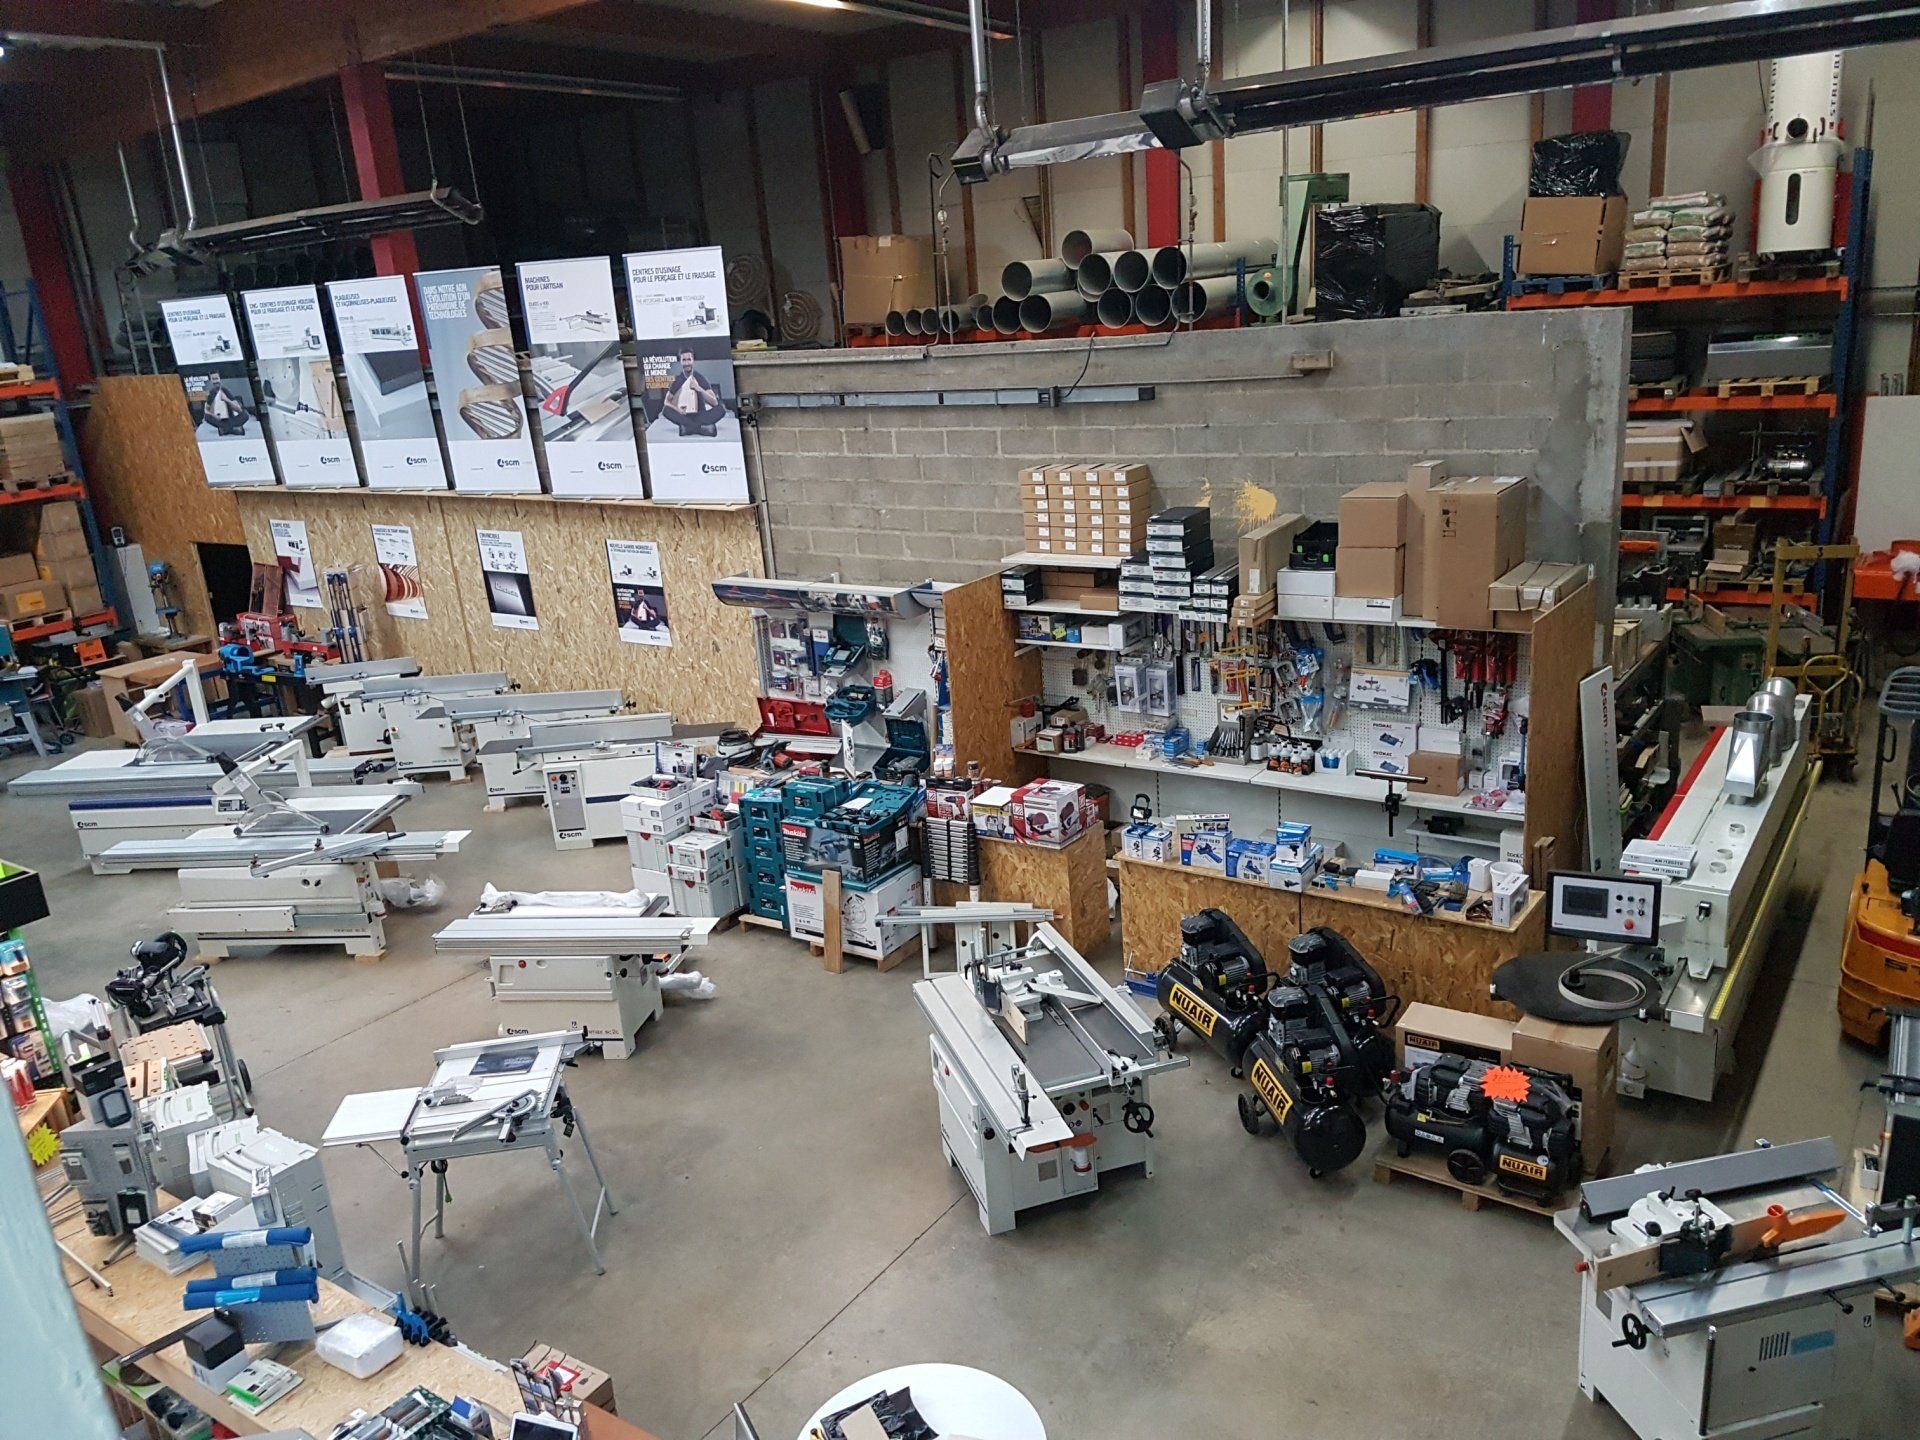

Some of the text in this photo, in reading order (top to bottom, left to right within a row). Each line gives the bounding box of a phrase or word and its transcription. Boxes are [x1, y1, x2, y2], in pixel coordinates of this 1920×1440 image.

[632, 268, 654, 276] CENTRES
[692, 271, 717, 279] FRAISAGE
[540, 282, 564, 290] L'ARTISAN
[649, 355, 677, 363] RÉVOLUTION
[783, 828, 807, 838] makita
[1172, 990, 1214, 1029] NUAIR
[1408, 1035, 1439, 1049] NUAIR
[1253, 1066, 1289, 1116] NUAIR
[1502, 1158, 1544, 1178] NUAIR
